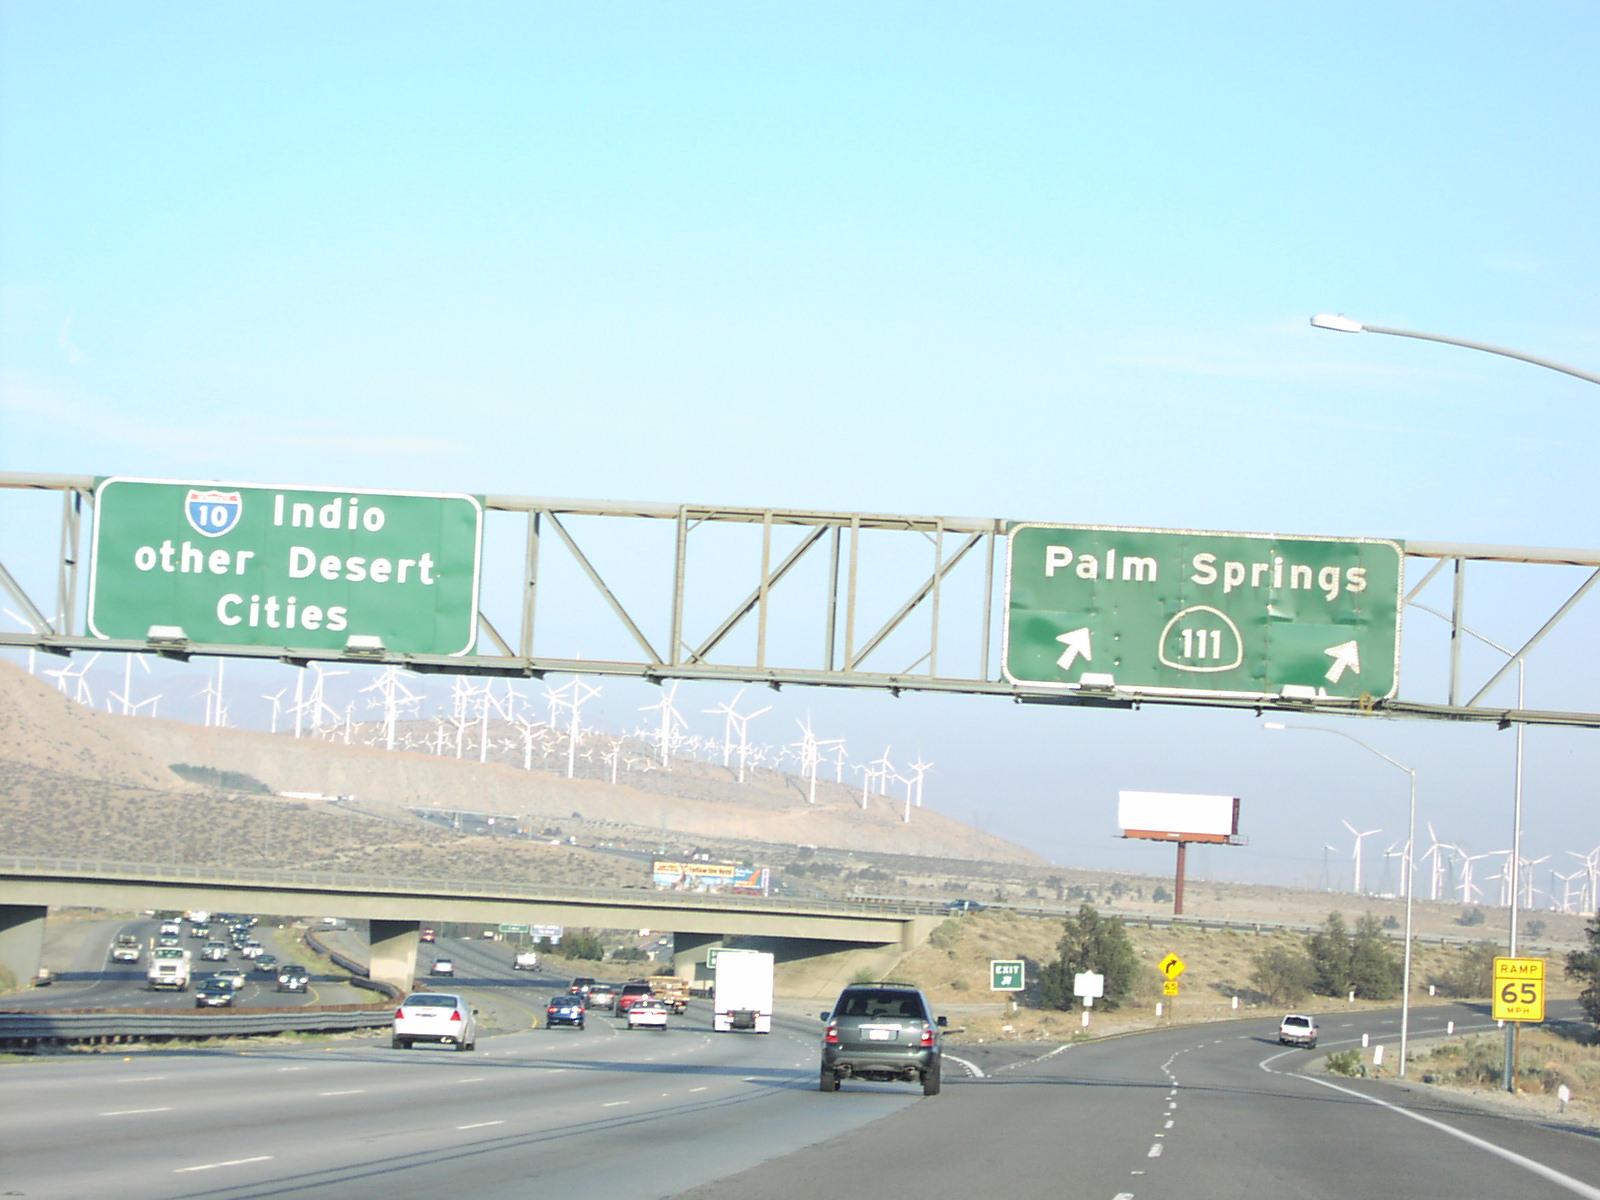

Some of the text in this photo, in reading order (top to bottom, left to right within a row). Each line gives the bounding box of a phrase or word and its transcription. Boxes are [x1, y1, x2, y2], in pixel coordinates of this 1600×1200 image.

[199, 505, 228, 528] 10
[273, 494, 386, 532] Indio
[134, 540, 435, 585] other Desert
[1045, 545, 1368, 602] Palm Springs
[216, 593, 348, 632] Cities
[1180, 628, 1222, 660] 111
[995, 965, 1020, 975] EXIT
[1500, 964, 1538, 974] RAMP
[1501, 982, 1537, 1005] 65
[1507, 1007, 1530, 1015] MPH
